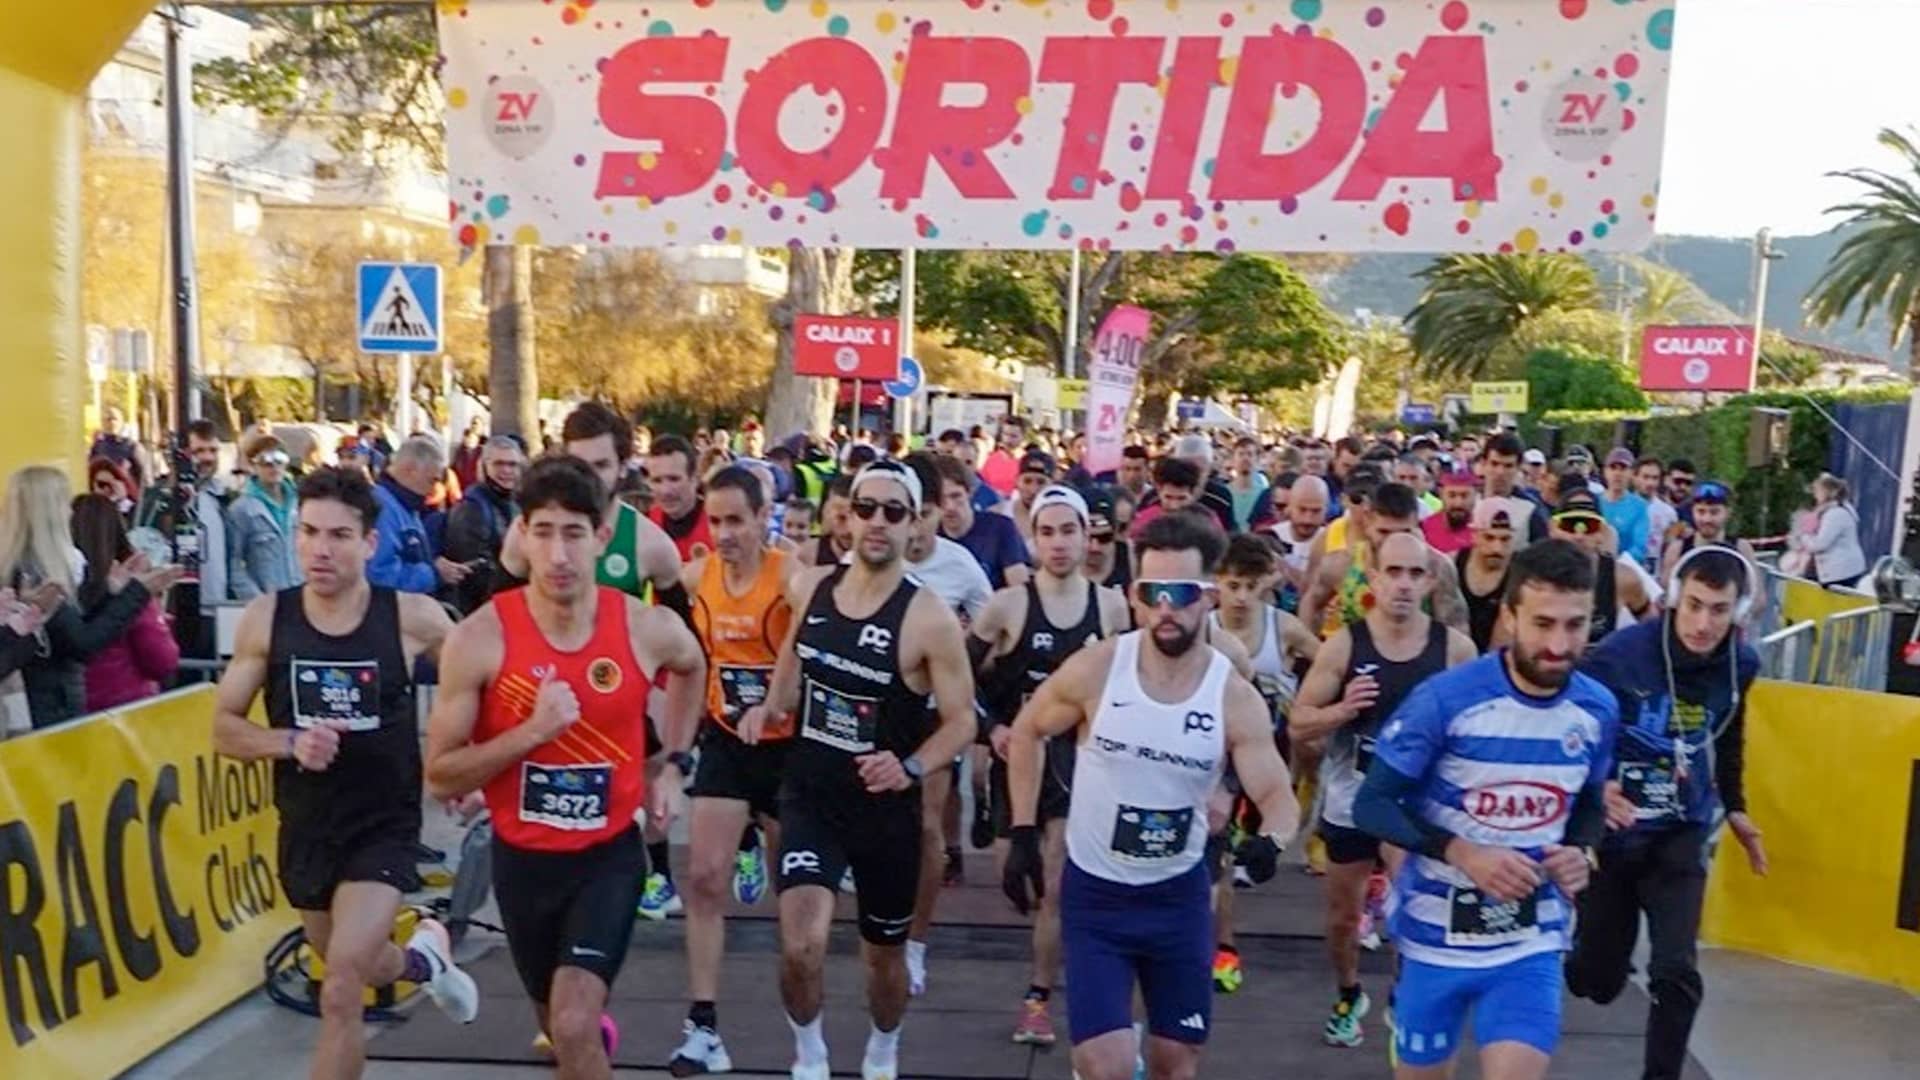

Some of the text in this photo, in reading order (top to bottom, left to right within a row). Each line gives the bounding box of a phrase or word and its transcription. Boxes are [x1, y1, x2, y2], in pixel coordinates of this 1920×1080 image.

[497, 92, 538, 121] ZV
[594, 36, 1498, 202] SORTIDA
[1558, 93, 1607, 122] ZV
[806, 324, 874, 345] CALAIX
[1653, 336, 1728, 356] CALAIX
[541, 793, 600, 816] 3672
[0, 762, 201, 1047] RACC
